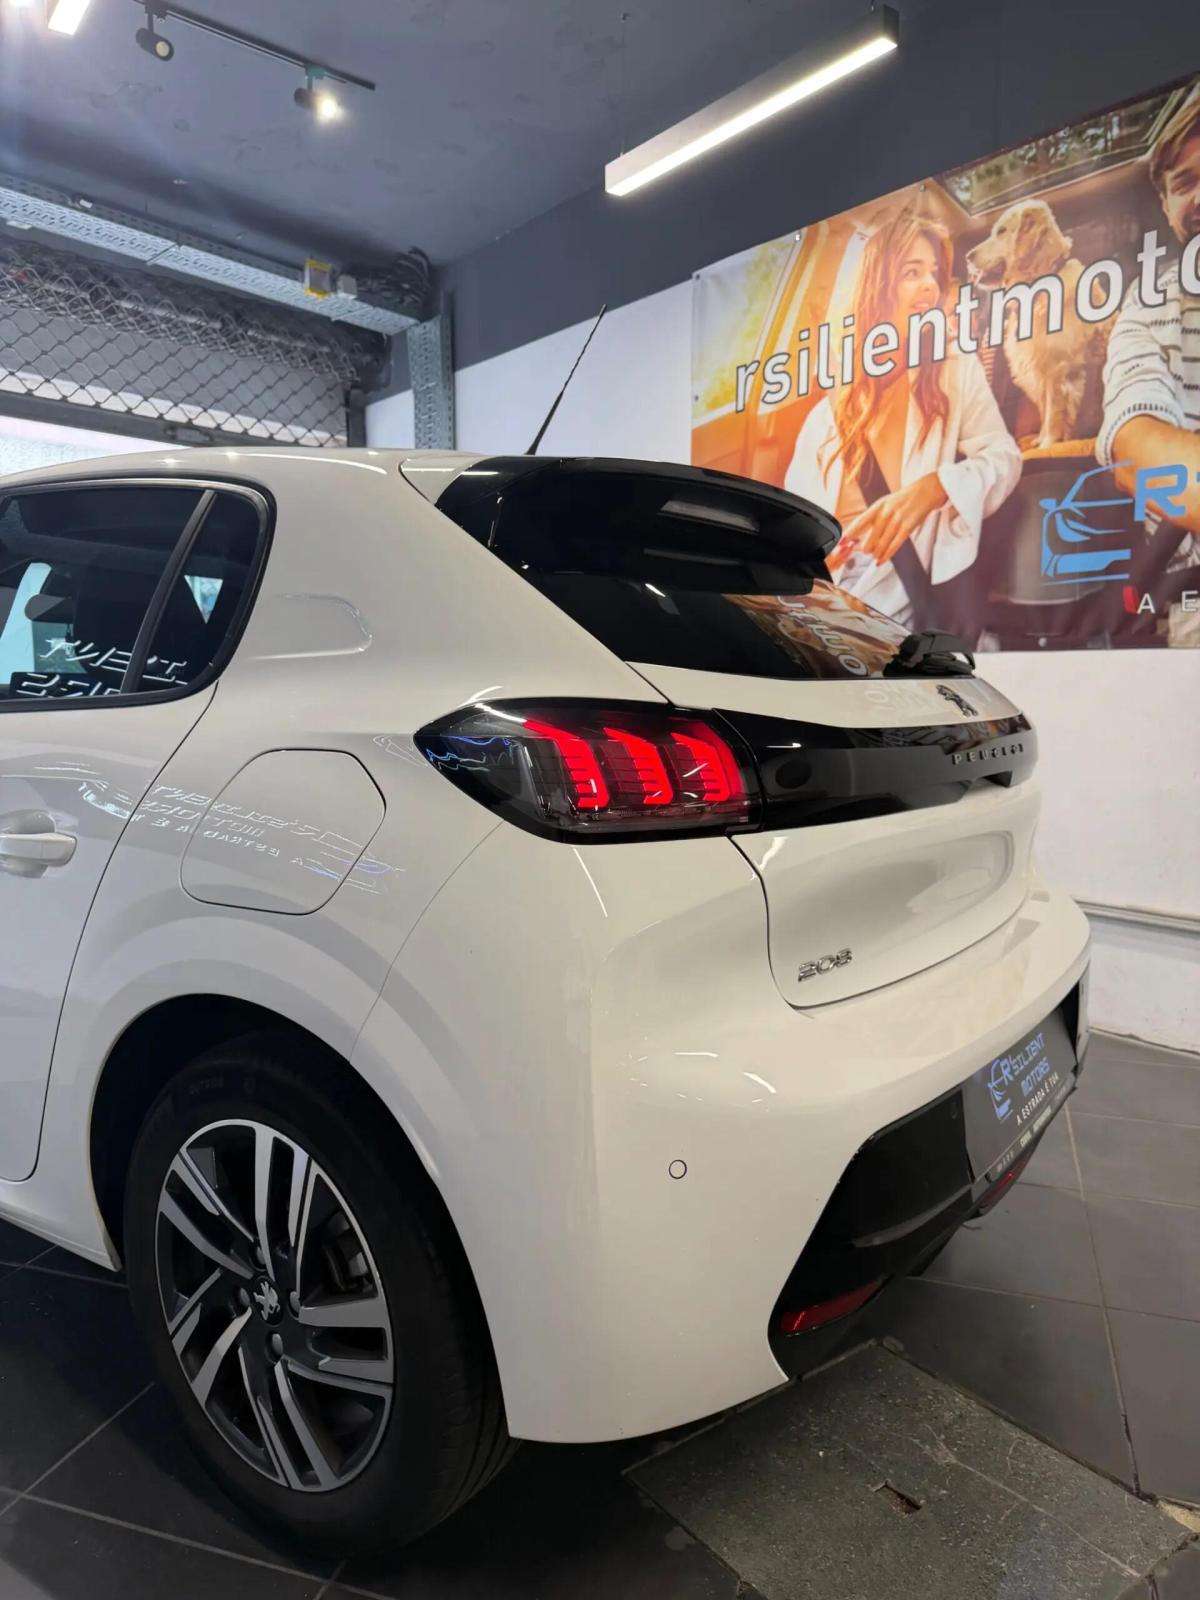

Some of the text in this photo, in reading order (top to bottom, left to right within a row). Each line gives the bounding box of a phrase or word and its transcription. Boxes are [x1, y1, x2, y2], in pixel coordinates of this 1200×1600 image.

[1134, 464, 1200, 522] R
[1137, 592, 1156, 614] A
[798, 947, 853, 982] 208
